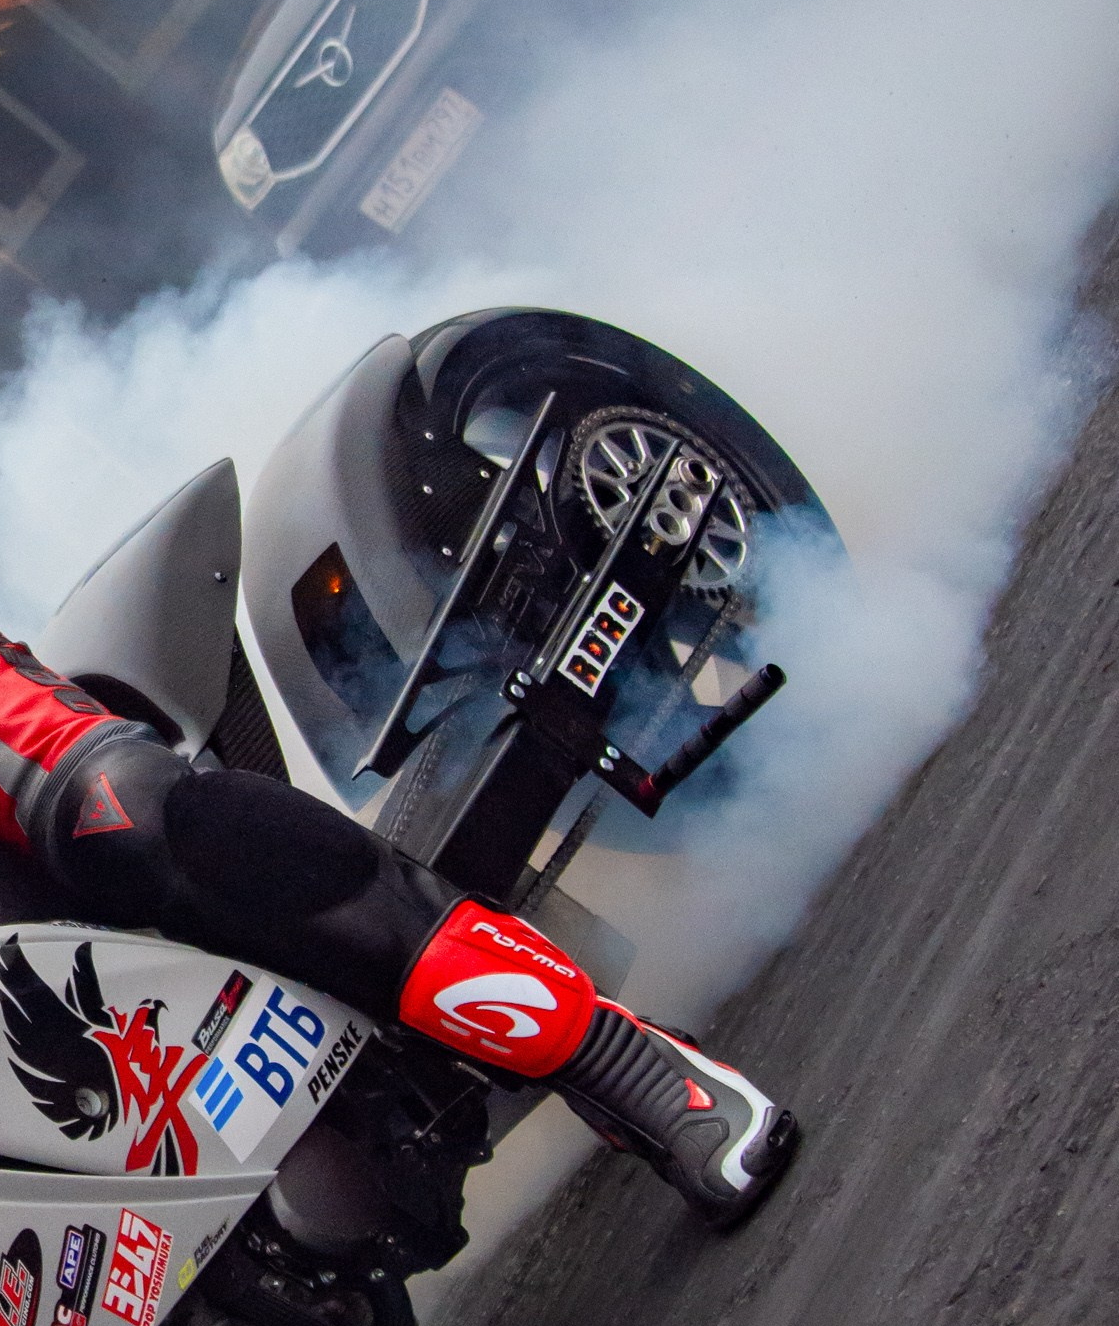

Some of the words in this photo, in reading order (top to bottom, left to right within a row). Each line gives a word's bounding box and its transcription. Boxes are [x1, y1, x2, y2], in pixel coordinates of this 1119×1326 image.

[234, 986, 326, 1109] ВТБ
[307, 1020, 364, 1106] PENSKE
[62, 1235, 82, 1286] APE
[150, 1233, 173, 1301] YOSHIMURA
